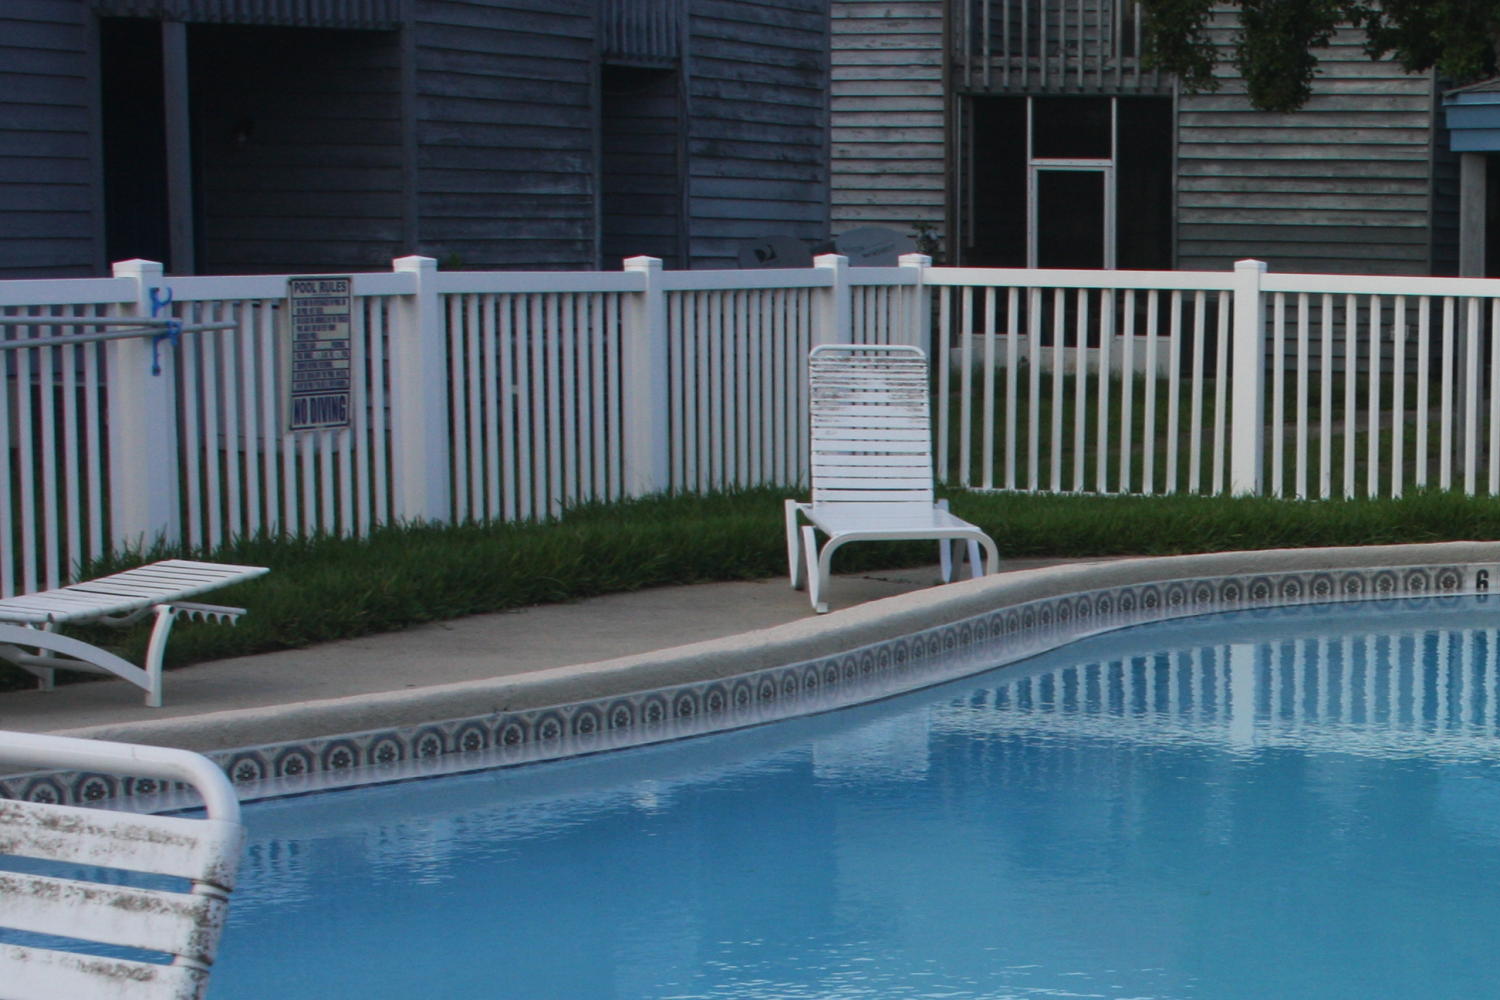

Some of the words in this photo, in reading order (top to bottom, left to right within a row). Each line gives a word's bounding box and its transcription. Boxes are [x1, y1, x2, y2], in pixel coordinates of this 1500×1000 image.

[294, 281, 316, 293] POOL
[319, 281, 346, 293] RULES
[293, 398, 308, 425] NO
[310, 395, 347, 424] DIVING
[1476, 568, 1489, 589] 6
